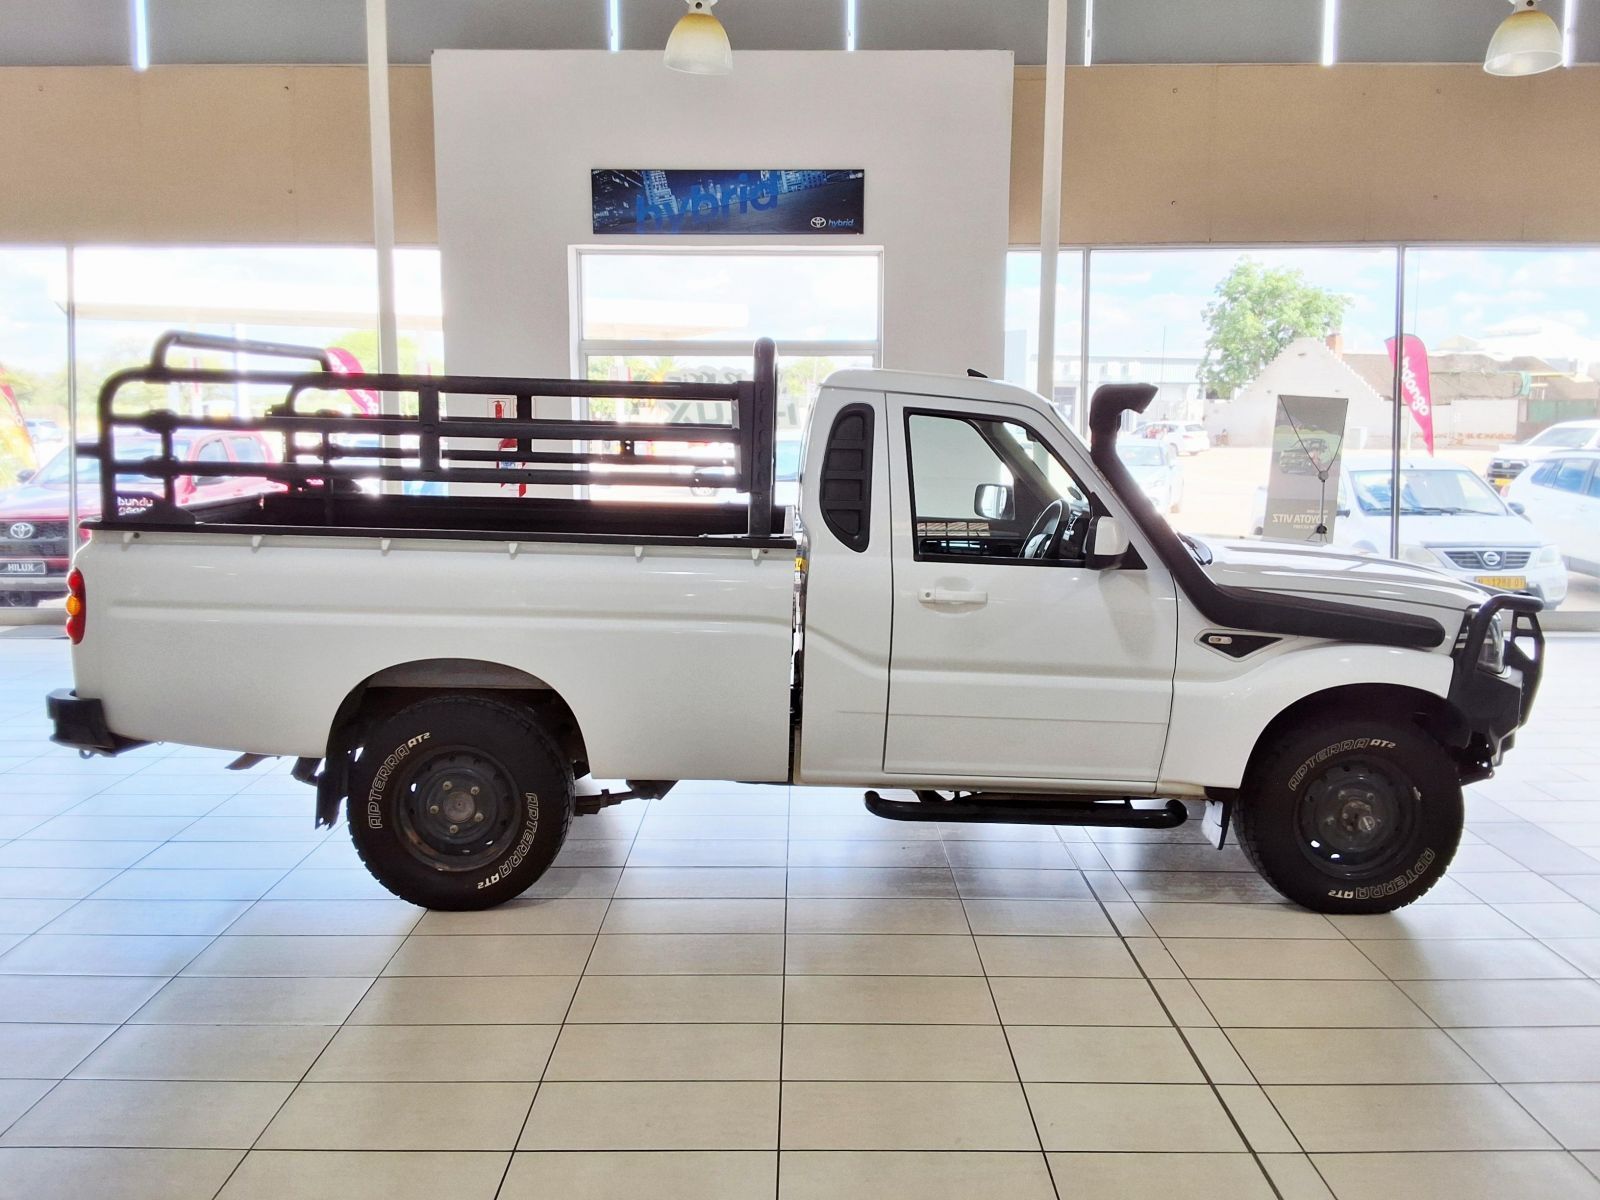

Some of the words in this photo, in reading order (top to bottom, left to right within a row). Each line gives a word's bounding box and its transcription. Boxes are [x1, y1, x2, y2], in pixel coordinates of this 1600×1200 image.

[635, 170, 779, 235] hybrid
[828, 218, 854, 227] hybrid
[117, 496, 153, 507] bundu
[8, 563, 34, 572] HILUX
[368, 743, 410, 829] APTERRA
[407, 731, 431, 748] AT2
[1288, 738, 1370, 791] APTERRA
[1370, 738, 1396, 749] AT2
[499, 792, 539, 878] APTERRA
[477, 873, 500, 889] AT2
[1355, 848, 1436, 899] APTERRA
[1328, 889, 1354, 899] AT2
